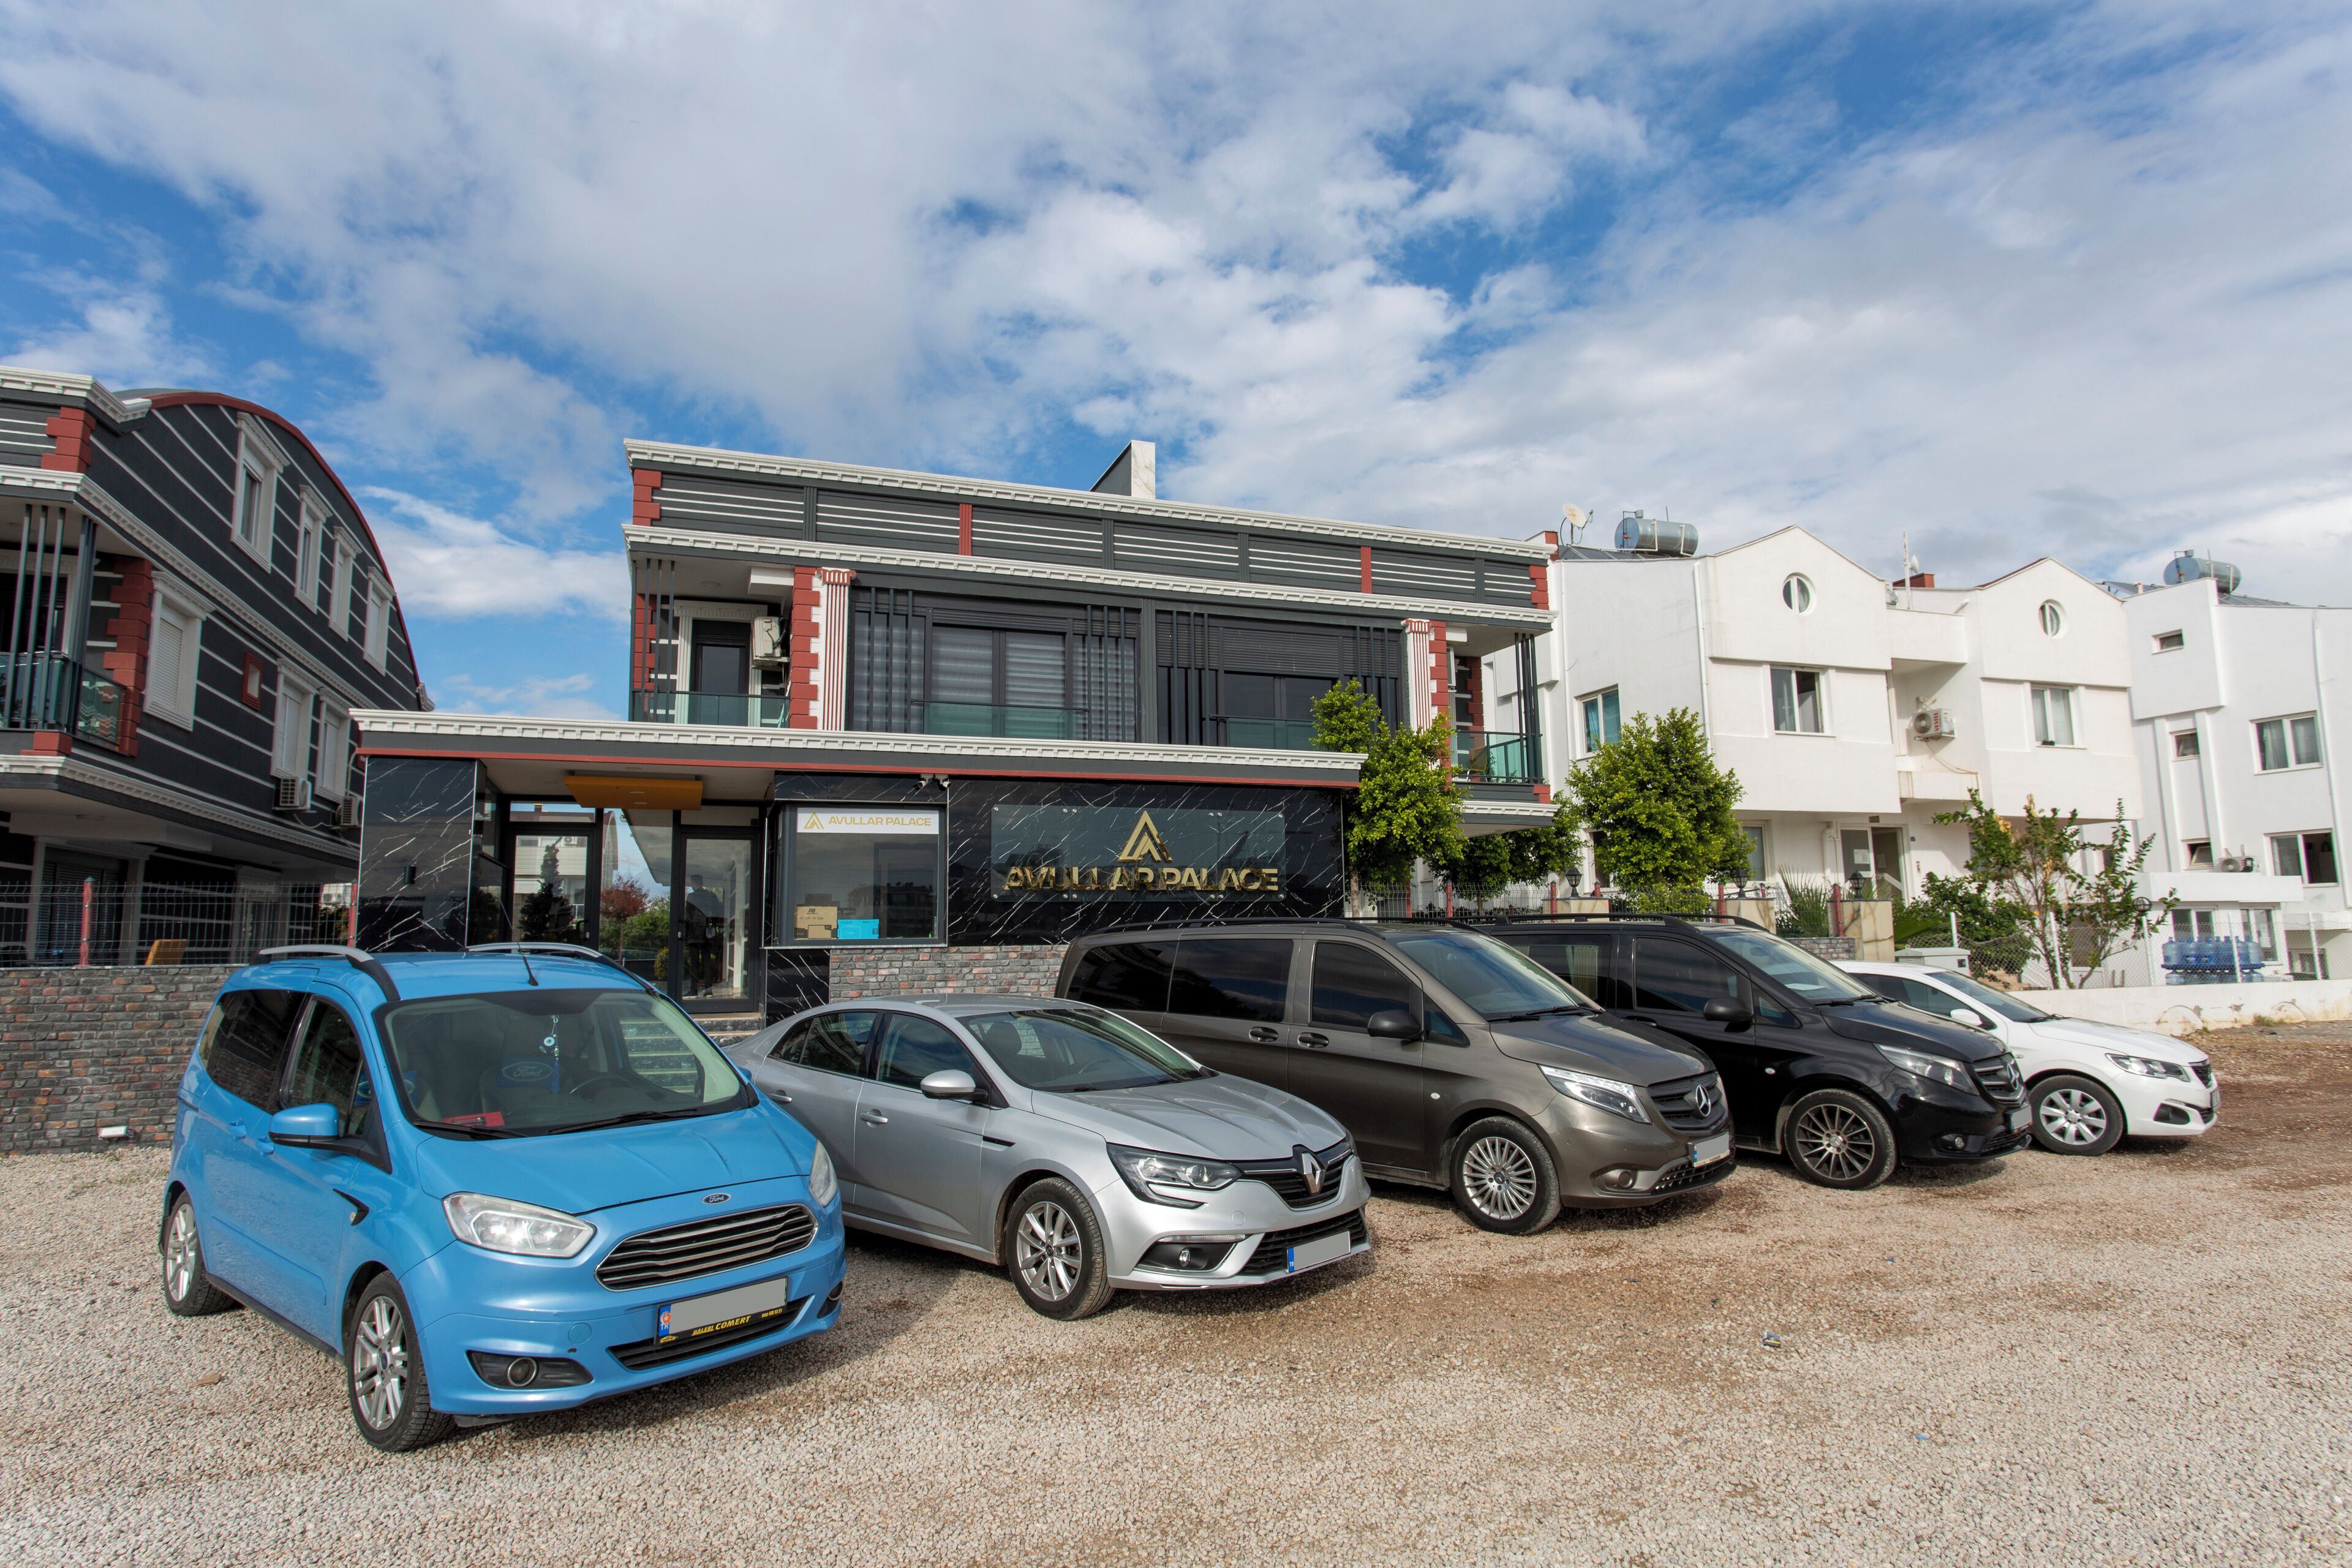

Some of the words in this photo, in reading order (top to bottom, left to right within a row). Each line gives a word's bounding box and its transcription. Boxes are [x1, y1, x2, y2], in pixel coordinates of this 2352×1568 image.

[829, 816, 883, 825] AVULLAR
[886, 817, 931, 826] PALACE
[1003, 866, 1155, 891] AVULLAR
[1161, 867, 1279, 891] PALACE
[513, 1066, 542, 1077] Ford
